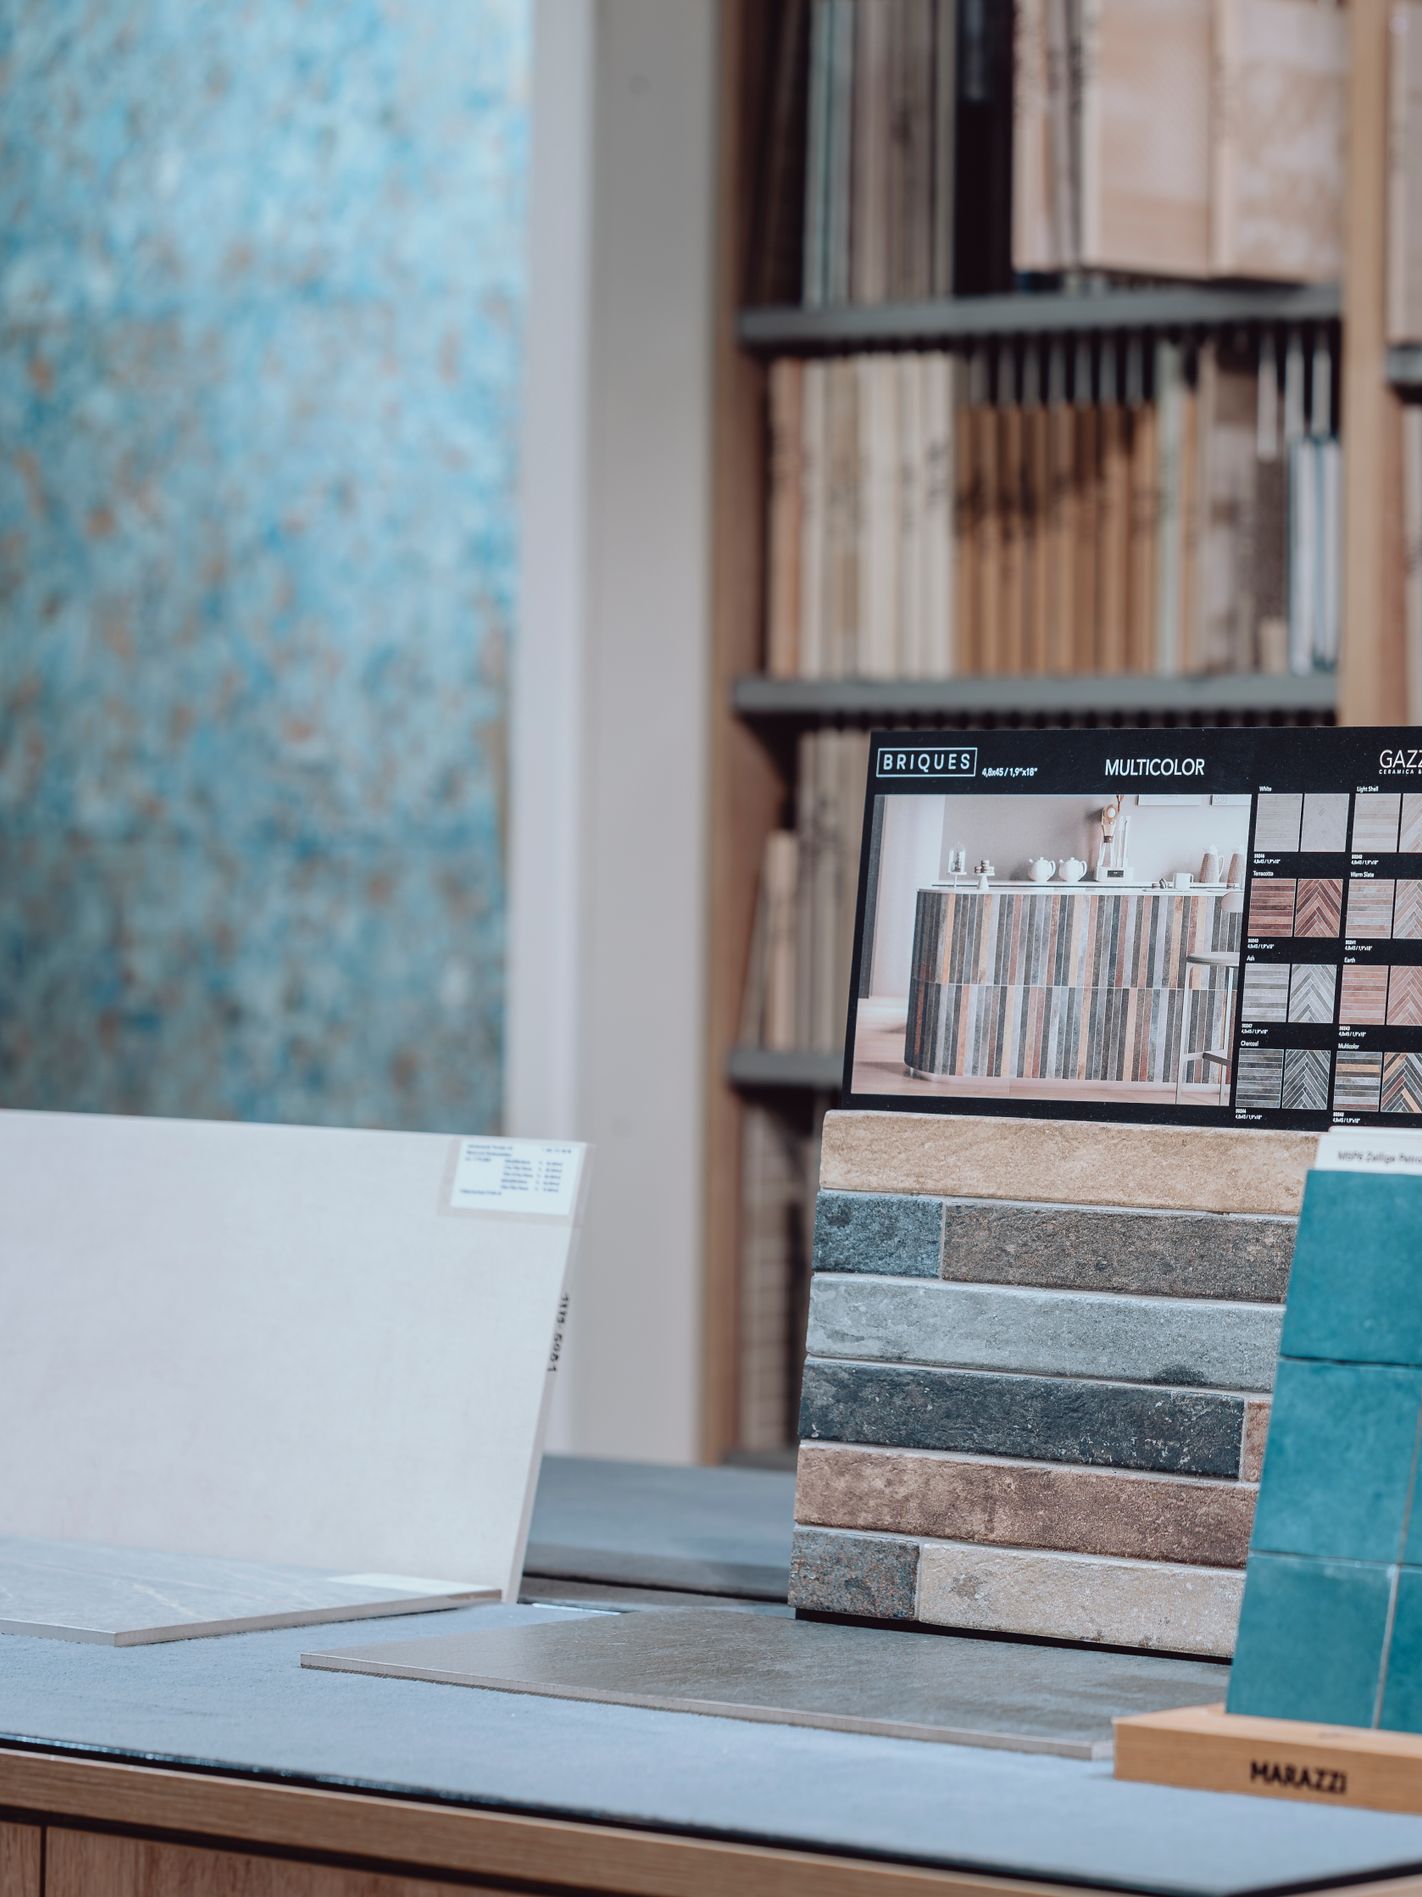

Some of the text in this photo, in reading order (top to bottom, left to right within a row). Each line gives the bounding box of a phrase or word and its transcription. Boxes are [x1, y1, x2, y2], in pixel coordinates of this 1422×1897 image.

[883, 753, 970, 773] BRIQUES
[1105, 758, 1205, 776] MULTICOLOR
[1249, 1760, 1347, 1795] MARAZZI
